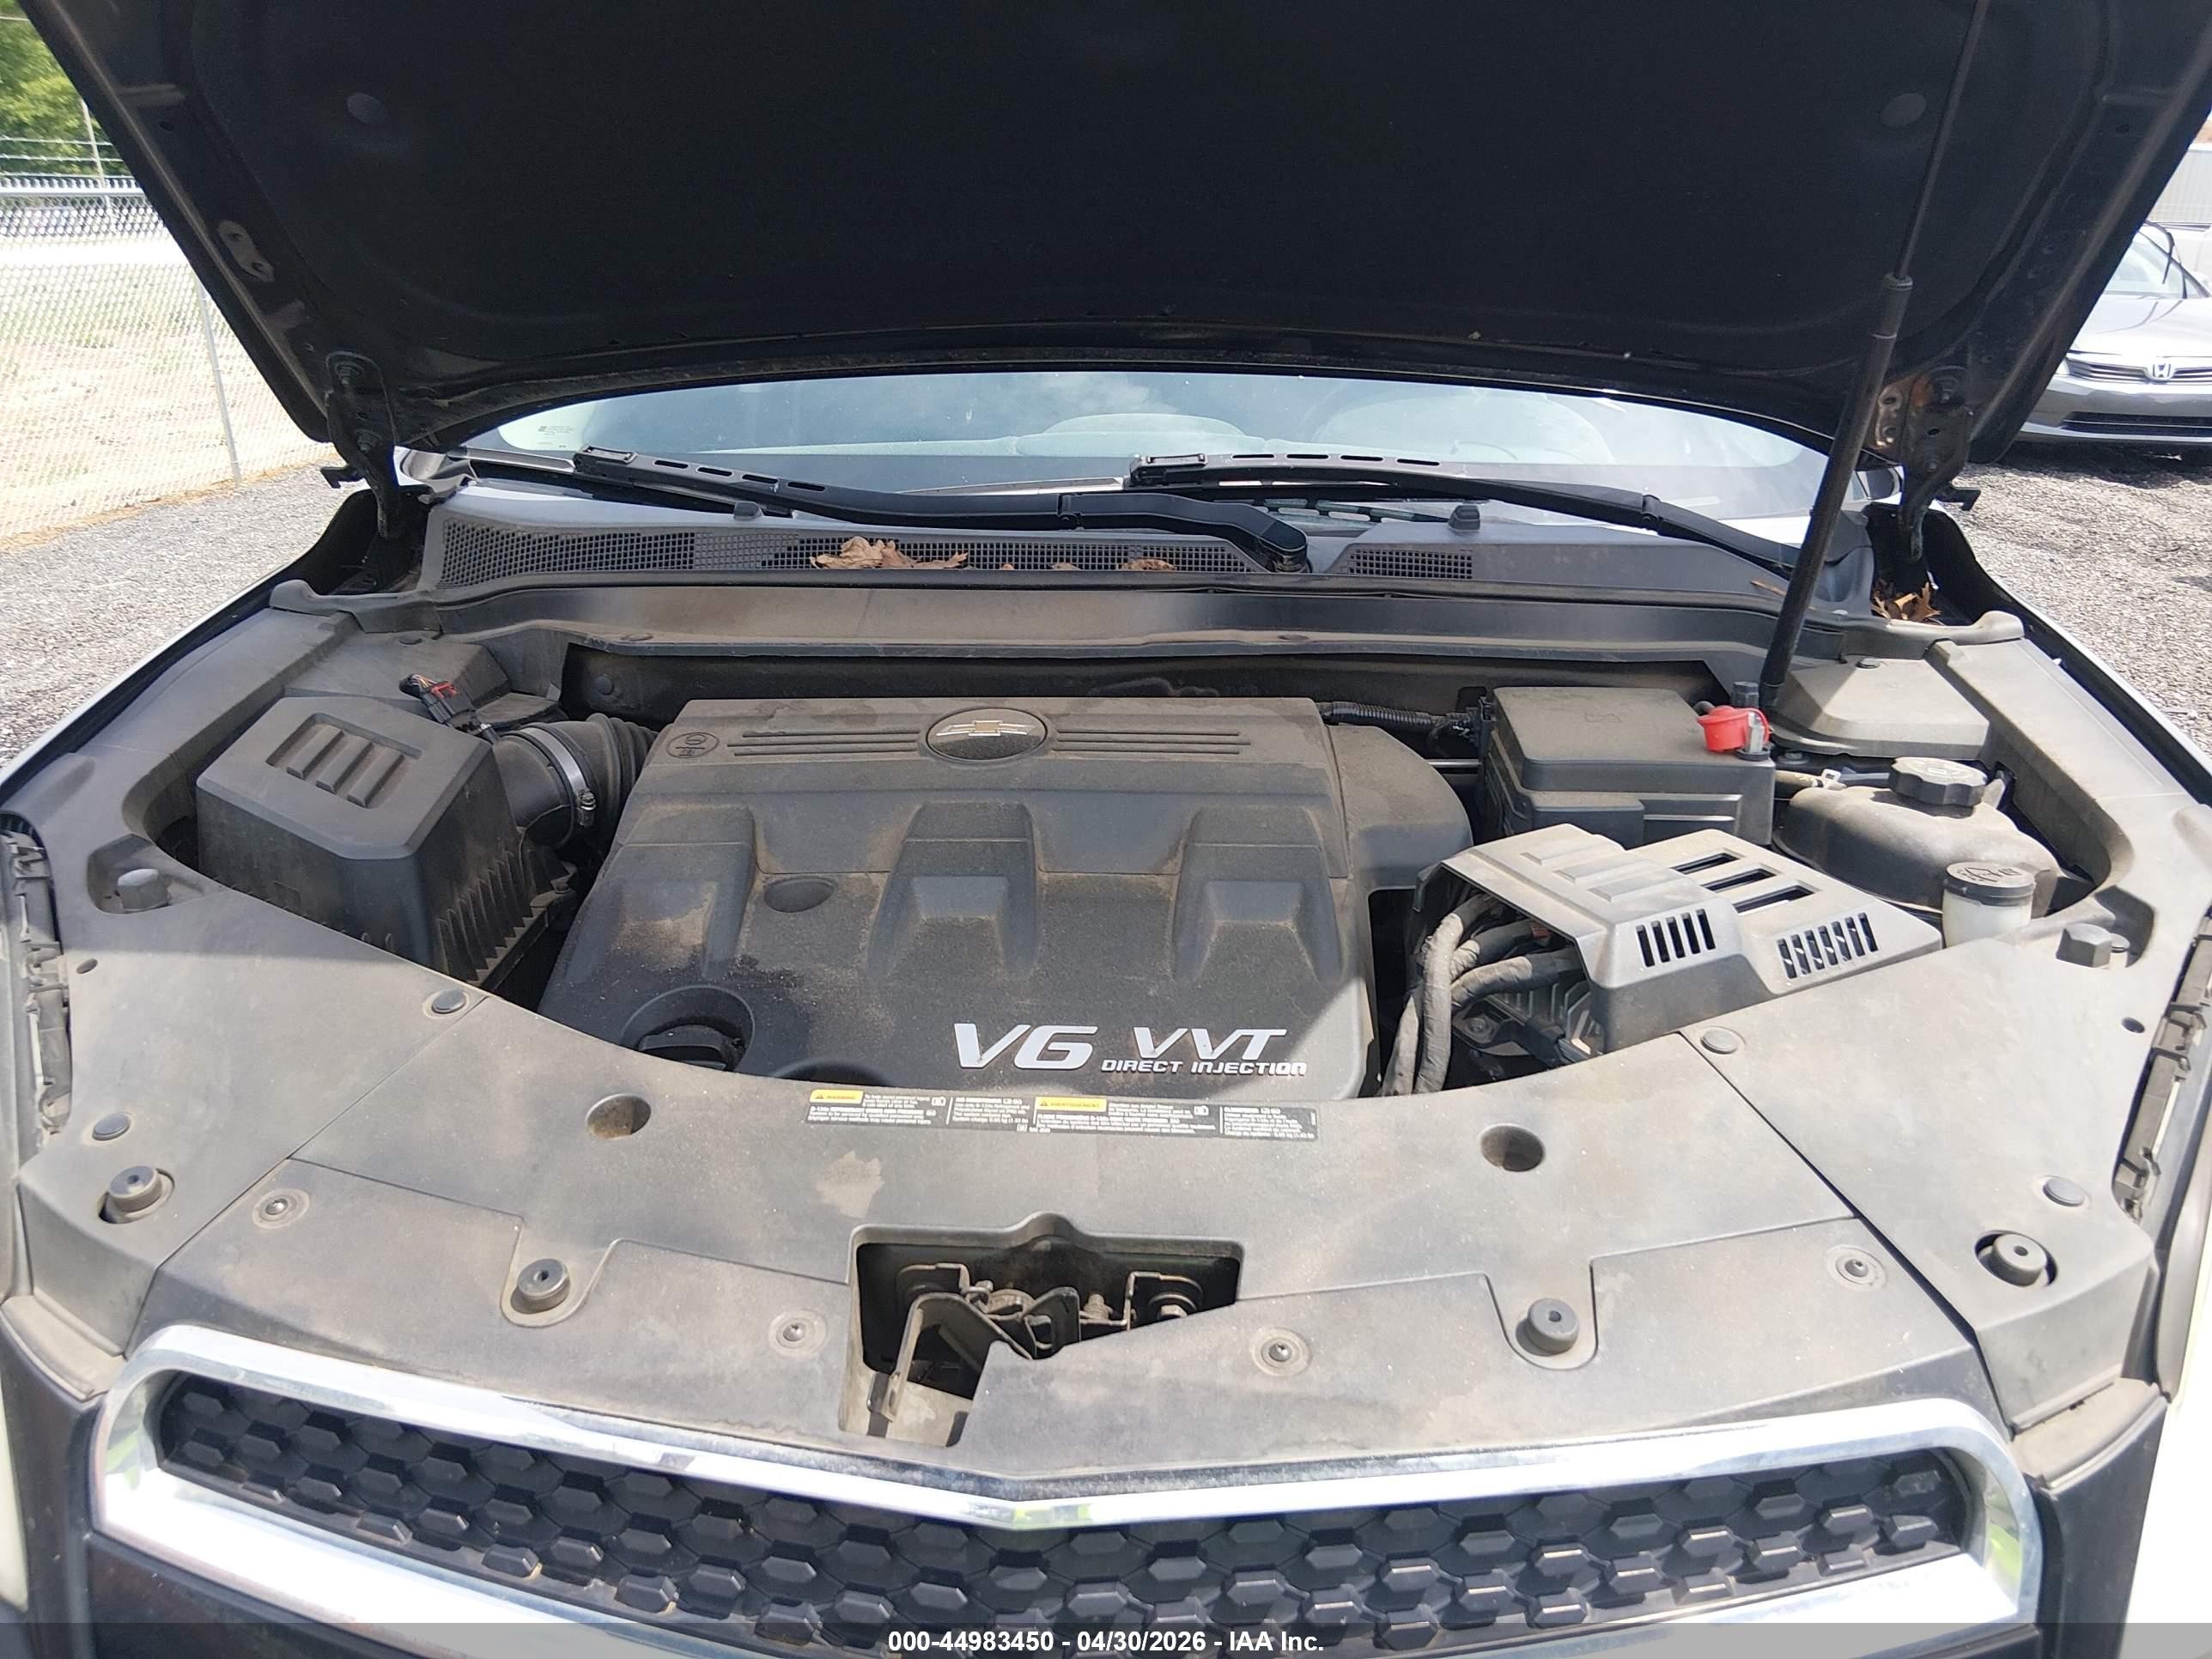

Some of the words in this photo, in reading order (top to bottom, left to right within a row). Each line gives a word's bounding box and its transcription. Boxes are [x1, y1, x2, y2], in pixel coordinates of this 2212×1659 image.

[954, 1023, 1098, 1071] V6
[1133, 1026, 1288, 1061] VVT
[1101, 1059, 1183, 1074] DIRECT
[1190, 1061, 1307, 1077] INJECTION
